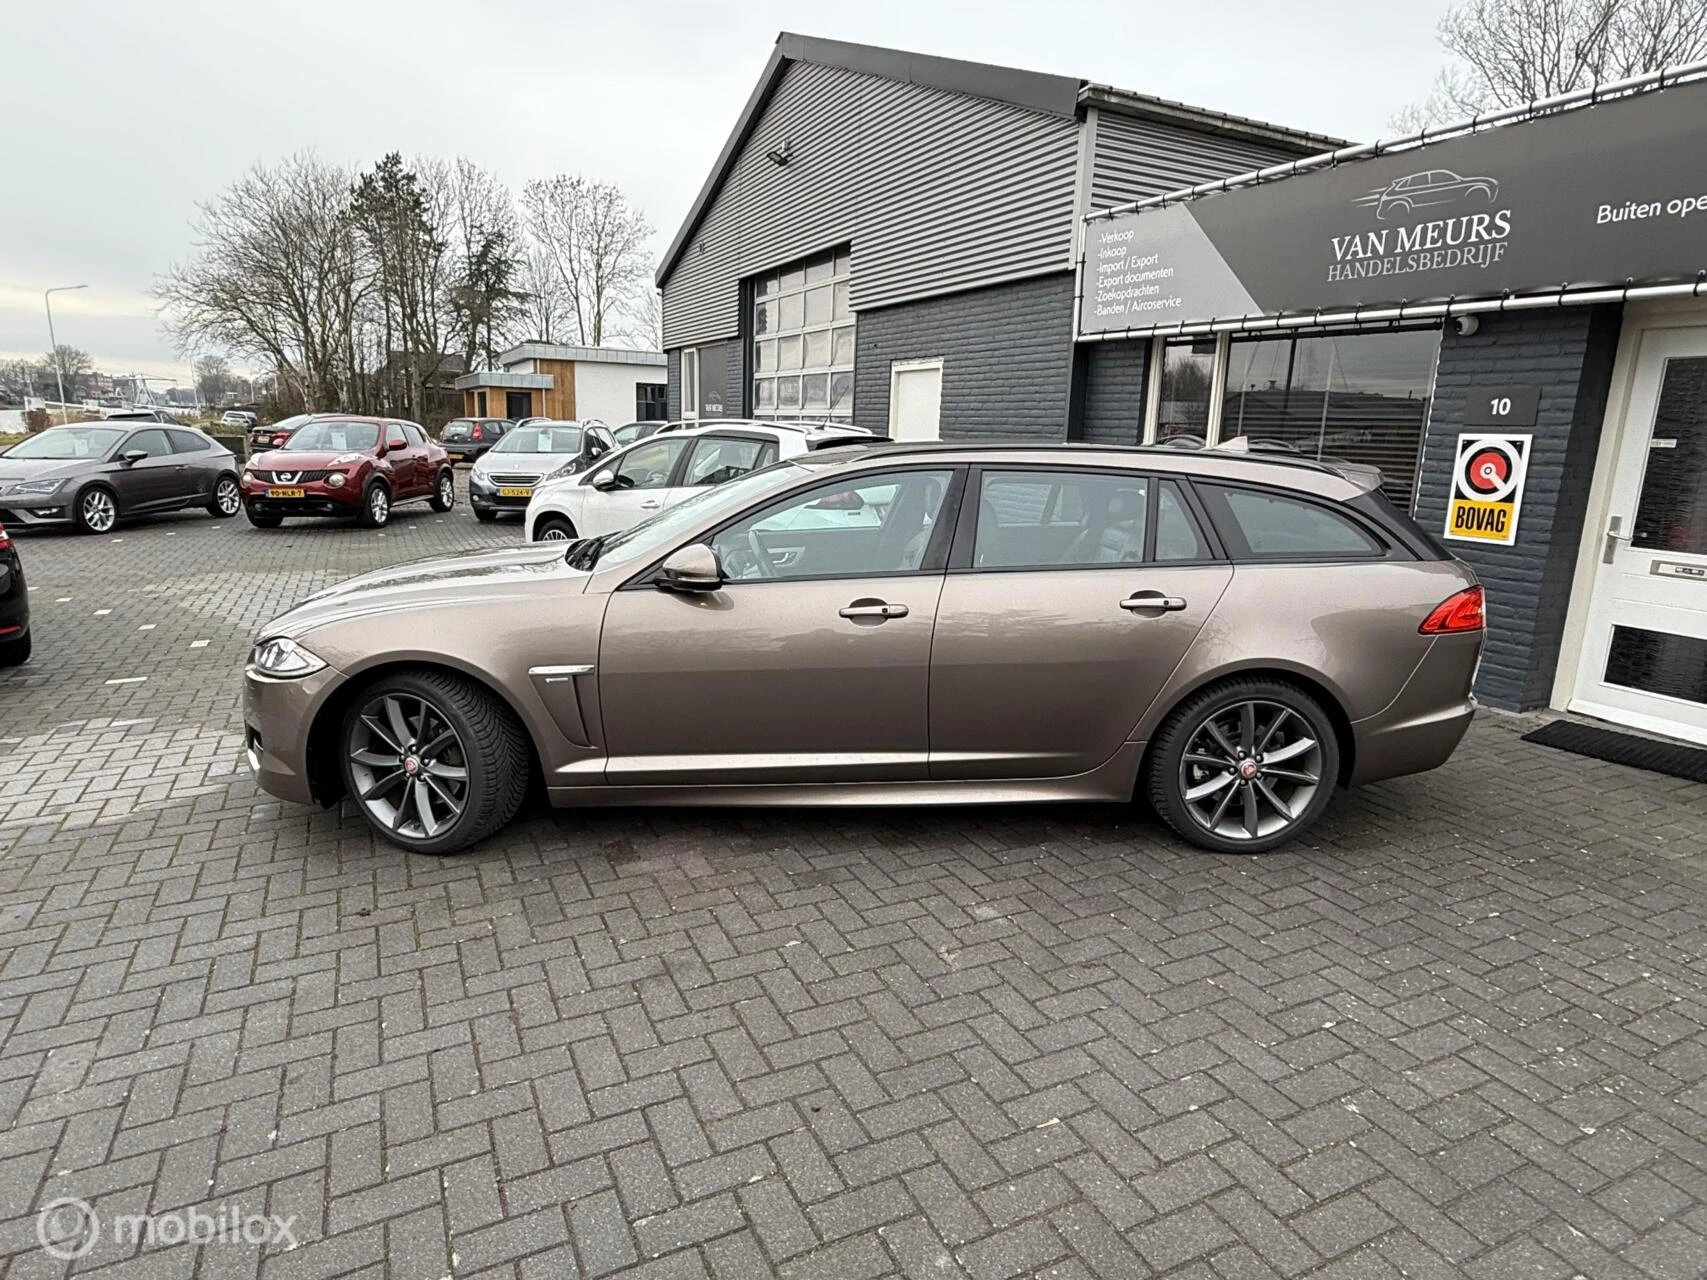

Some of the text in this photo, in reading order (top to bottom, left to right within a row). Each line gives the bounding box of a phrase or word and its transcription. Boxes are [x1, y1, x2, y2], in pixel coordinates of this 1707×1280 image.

[1596, 201, 1662, 224] Buiten
[1098, 230, 1135, 244] -Verkoop
[1331, 209, 1512, 261] VAN MEURS
[1097, 246, 1127, 259] -Inkoop
[1327, 242, 1508, 282] HANDELSBEDRIJF
[1096, 259, 1125, 275] -Import
[1131, 253, 1159, 270] Export
[1095, 267, 1174, 289] -Export documenten
[1093, 302, 1125, 316] -Banden
[1131, 295, 1182, 313] Aircoservice
[1490, 397, 1511, 416] 10
[1455, 505, 1507, 533] BOVAG
